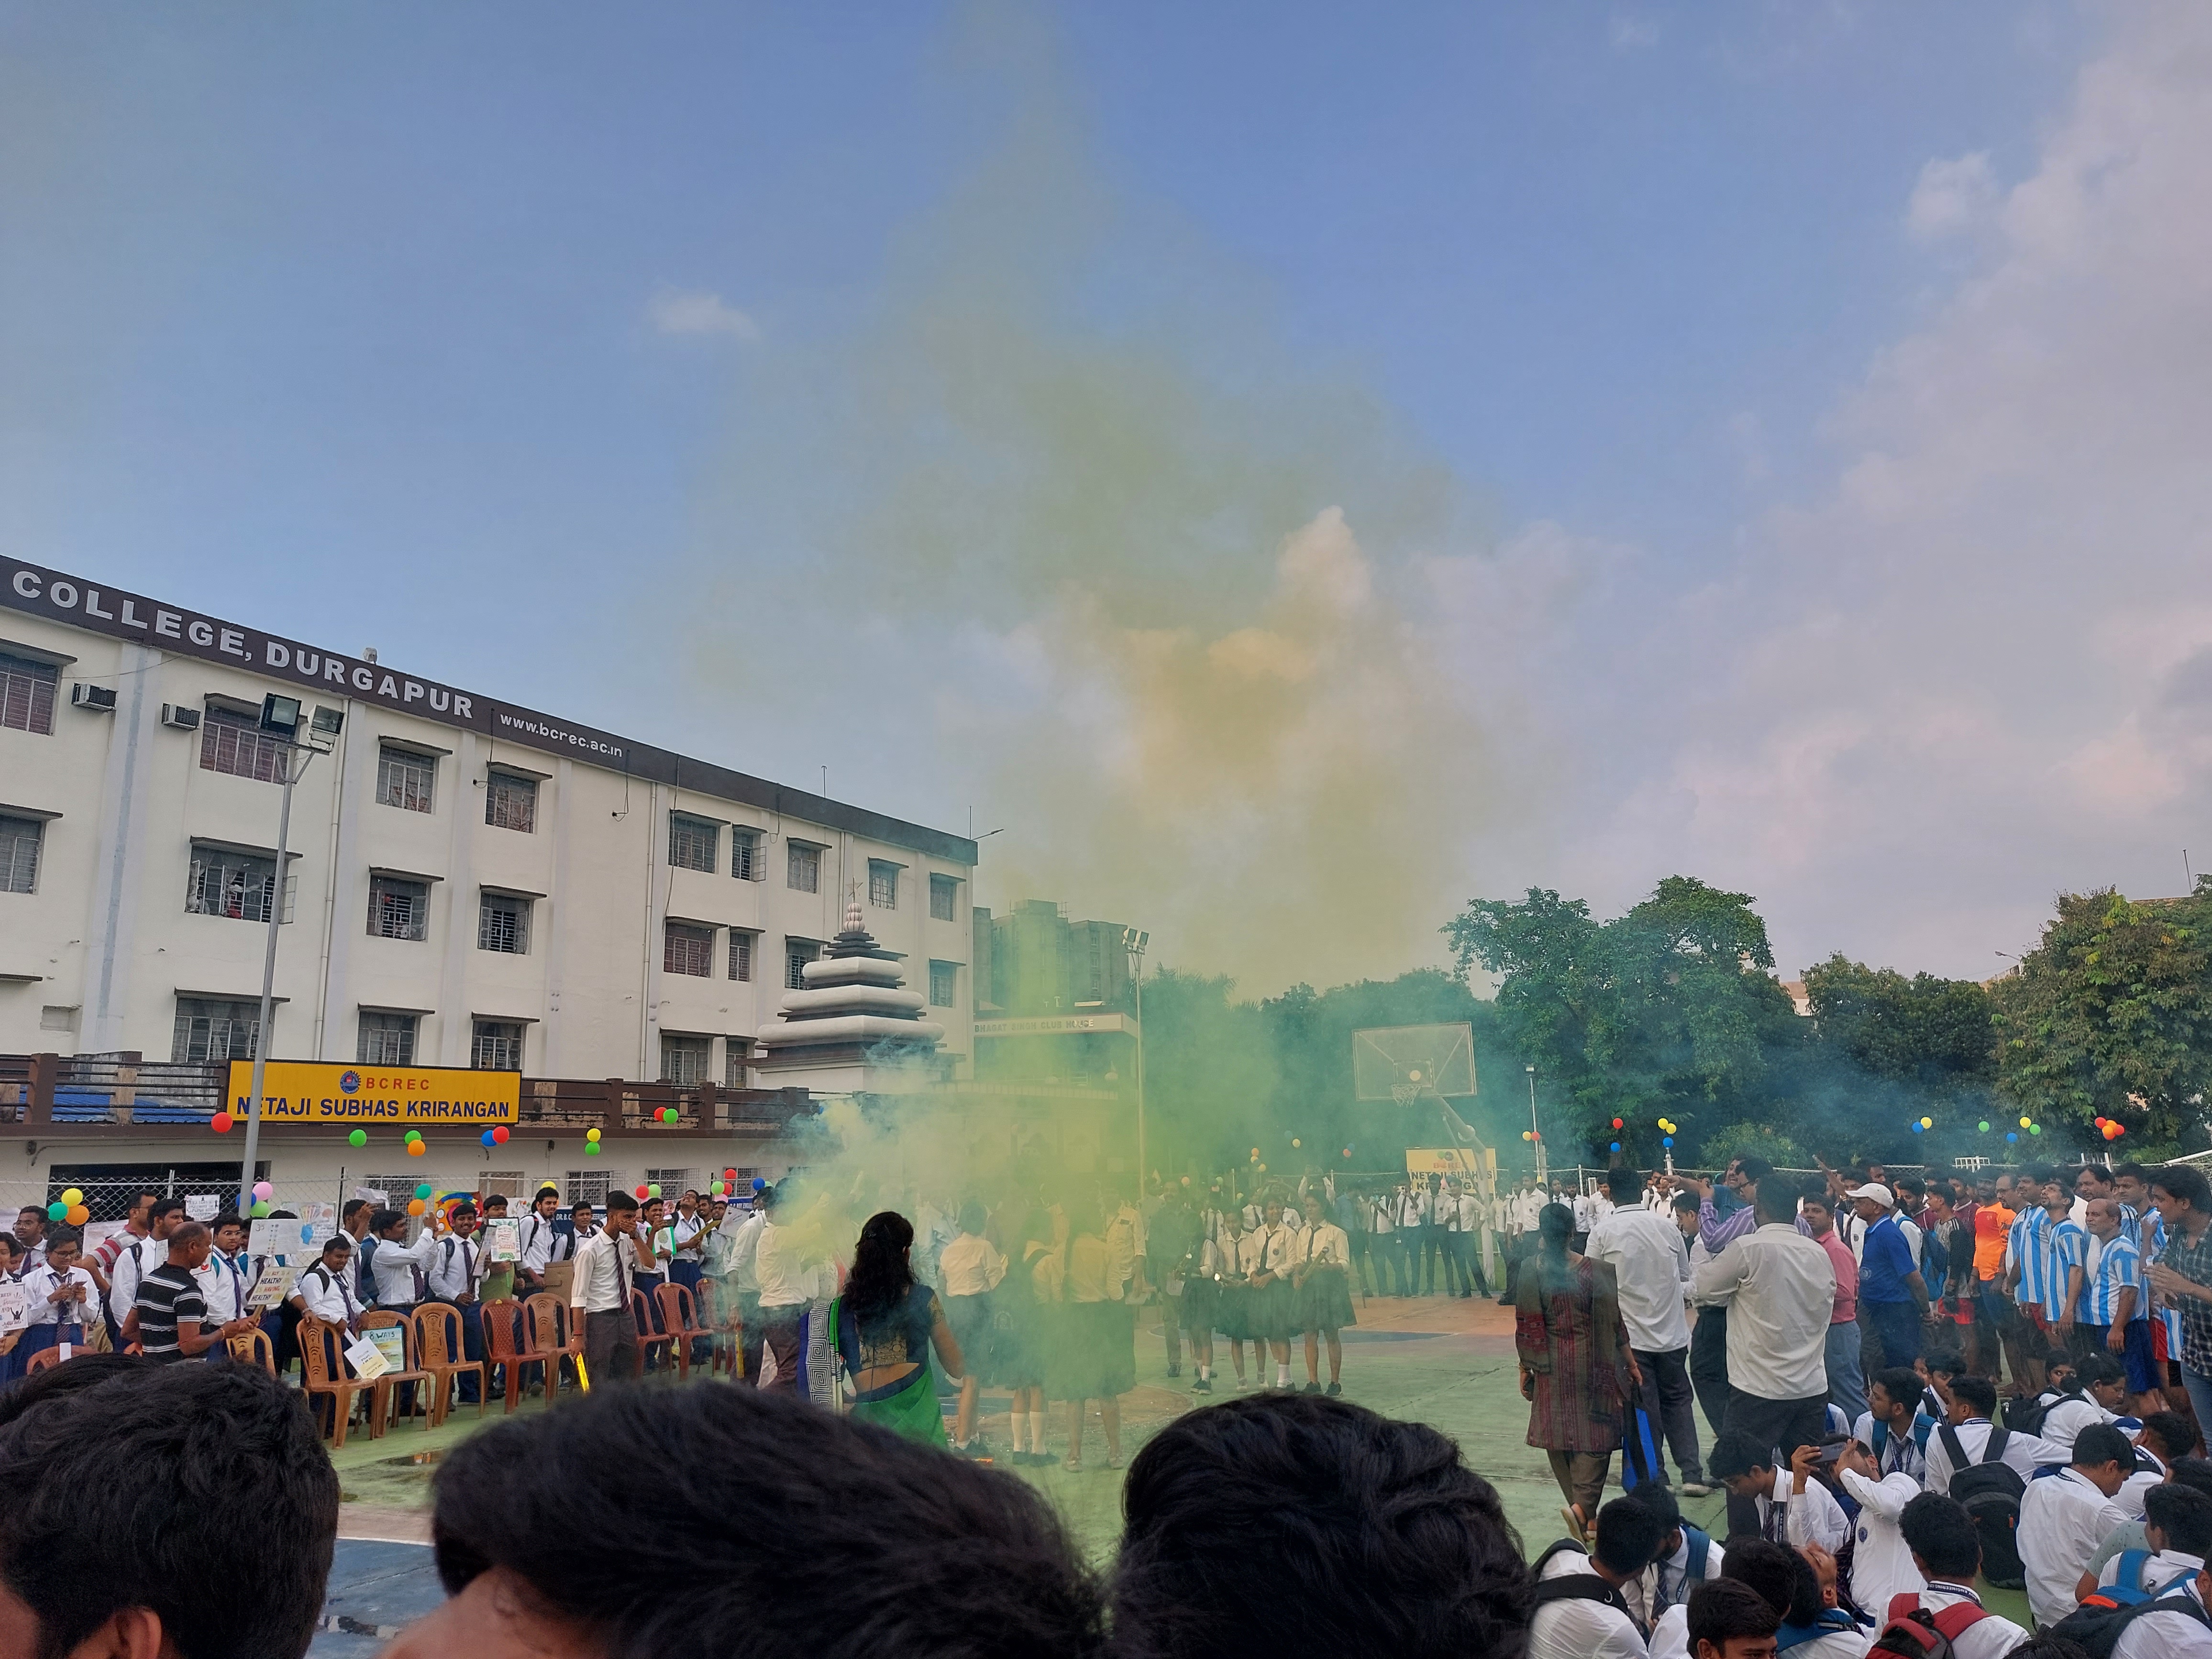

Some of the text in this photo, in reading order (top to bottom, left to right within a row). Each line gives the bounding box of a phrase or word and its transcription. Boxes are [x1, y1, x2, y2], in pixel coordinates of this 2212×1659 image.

[12, 570, 473, 719] COLLEGE, DURGAPUR
[500, 714, 622, 757] www.bcrec.ac.in
[974, 1024, 1006, 1032] BHAGAT
[1041, 1021, 1062, 1029] CLUB
[1066, 1019, 1094, 1028] HOUSE
[366, 1077, 429, 1090] BCREC
[237, 1096, 509, 1117] NTAJI SUBHAS KRIRANGAN
[1451, 1171, 1493, 1179] SUBHS
[370, 1331, 374, 1339] 8
